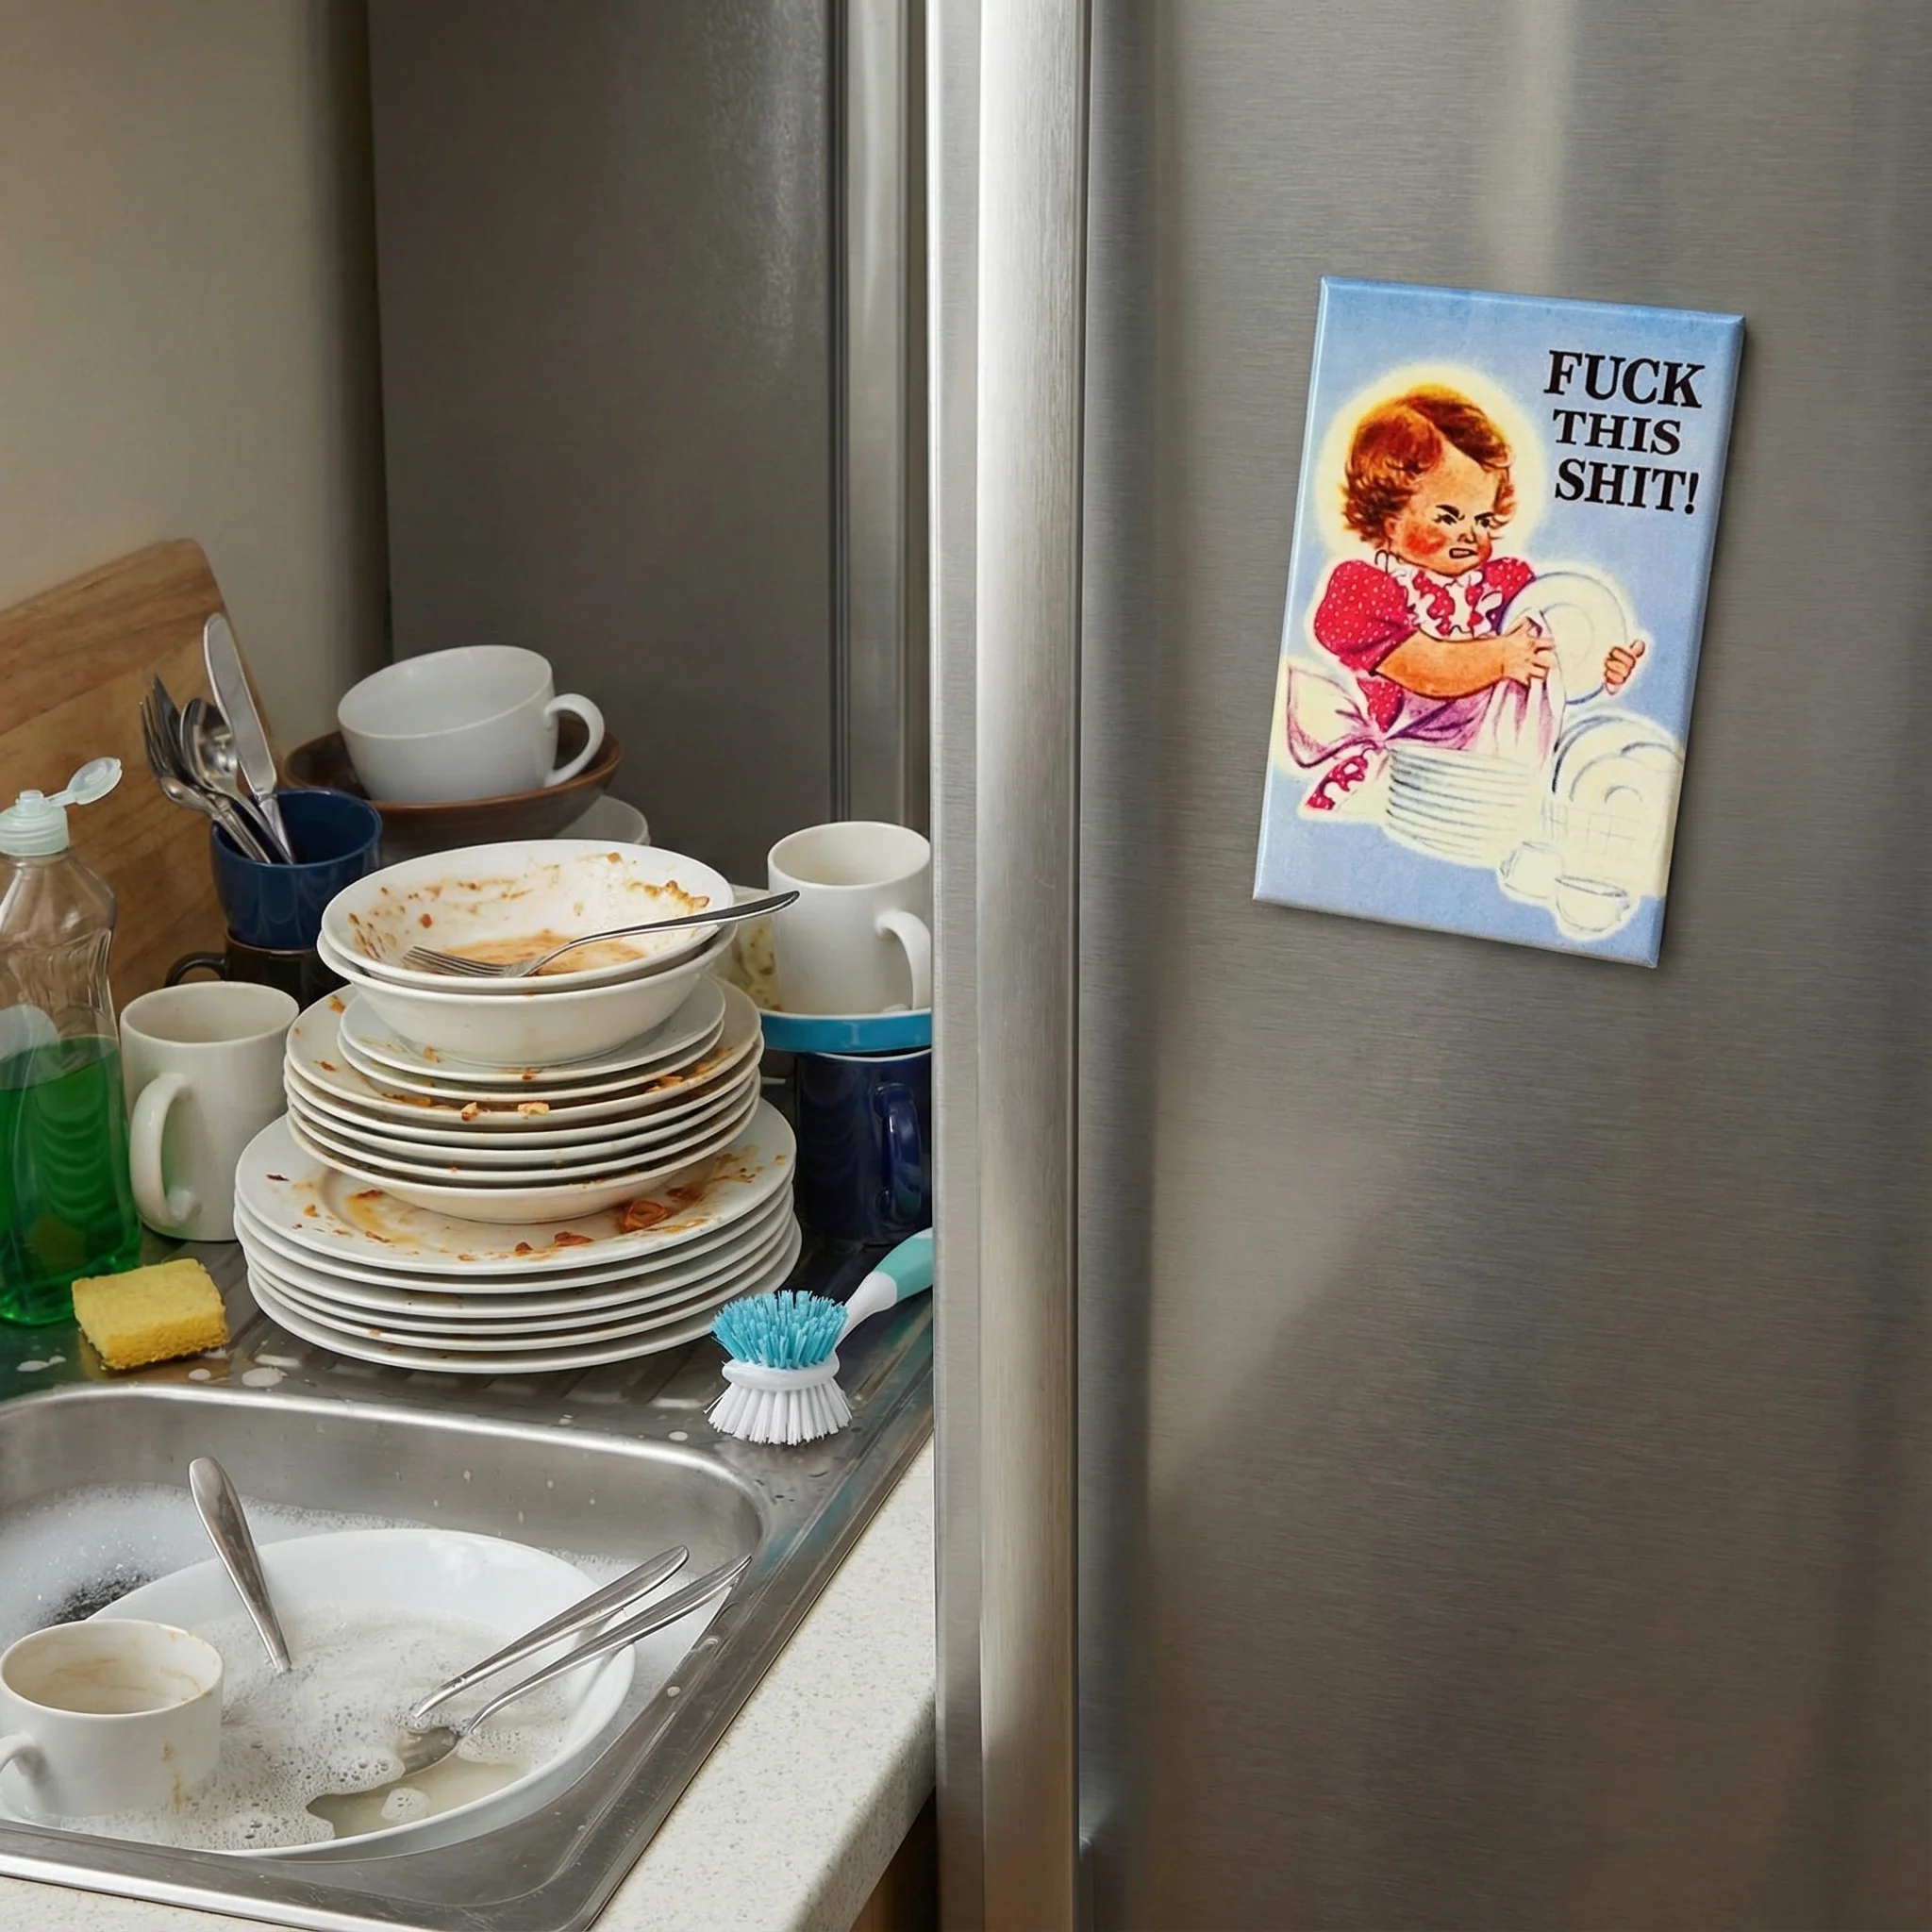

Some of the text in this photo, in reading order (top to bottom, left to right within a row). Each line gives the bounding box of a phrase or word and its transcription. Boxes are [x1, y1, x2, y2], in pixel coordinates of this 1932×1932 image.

[1542, 349, 1706, 409] FUCK
[1552, 408, 1681, 456] THIS
[1554, 458, 1699, 515] SHIT!
